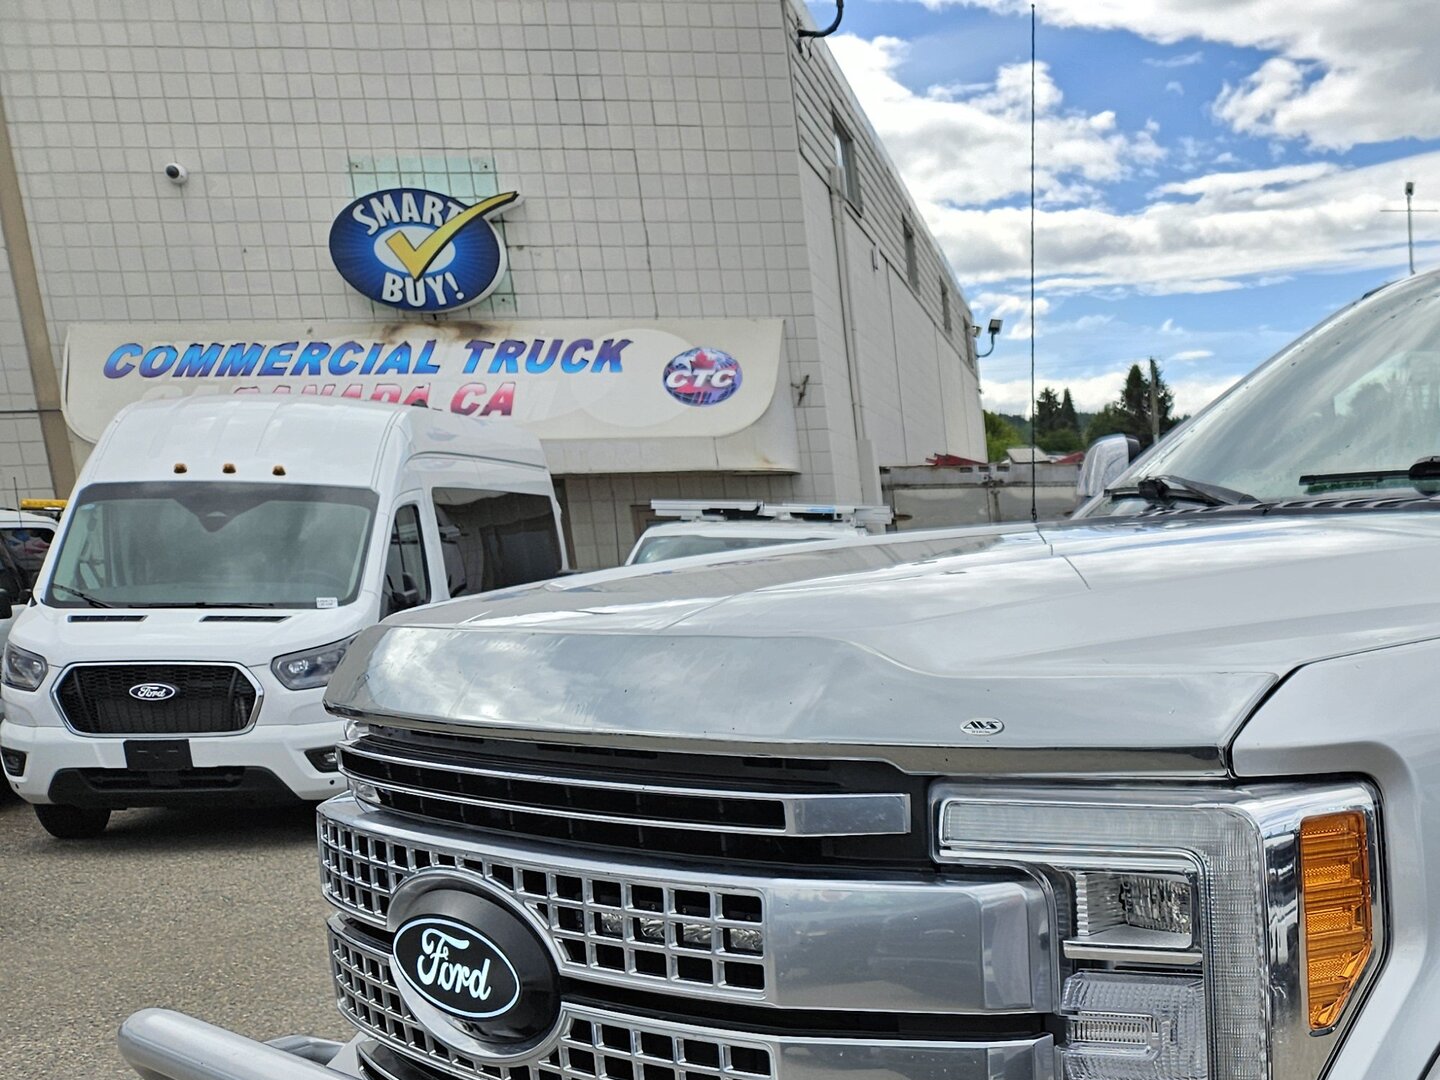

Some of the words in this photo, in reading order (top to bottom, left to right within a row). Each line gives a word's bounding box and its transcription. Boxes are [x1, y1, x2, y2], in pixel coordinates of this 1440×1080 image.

[352, 192, 466, 236] SMART
[381, 271, 465, 307] BUY!
[103, 338, 441, 379] COMMERCIAL
[462, 338, 634, 374] TRUCK
[665, 369, 736, 388] CTC
[138, 686, 166, 697] Ford
[417, 928, 492, 1001] Ford
